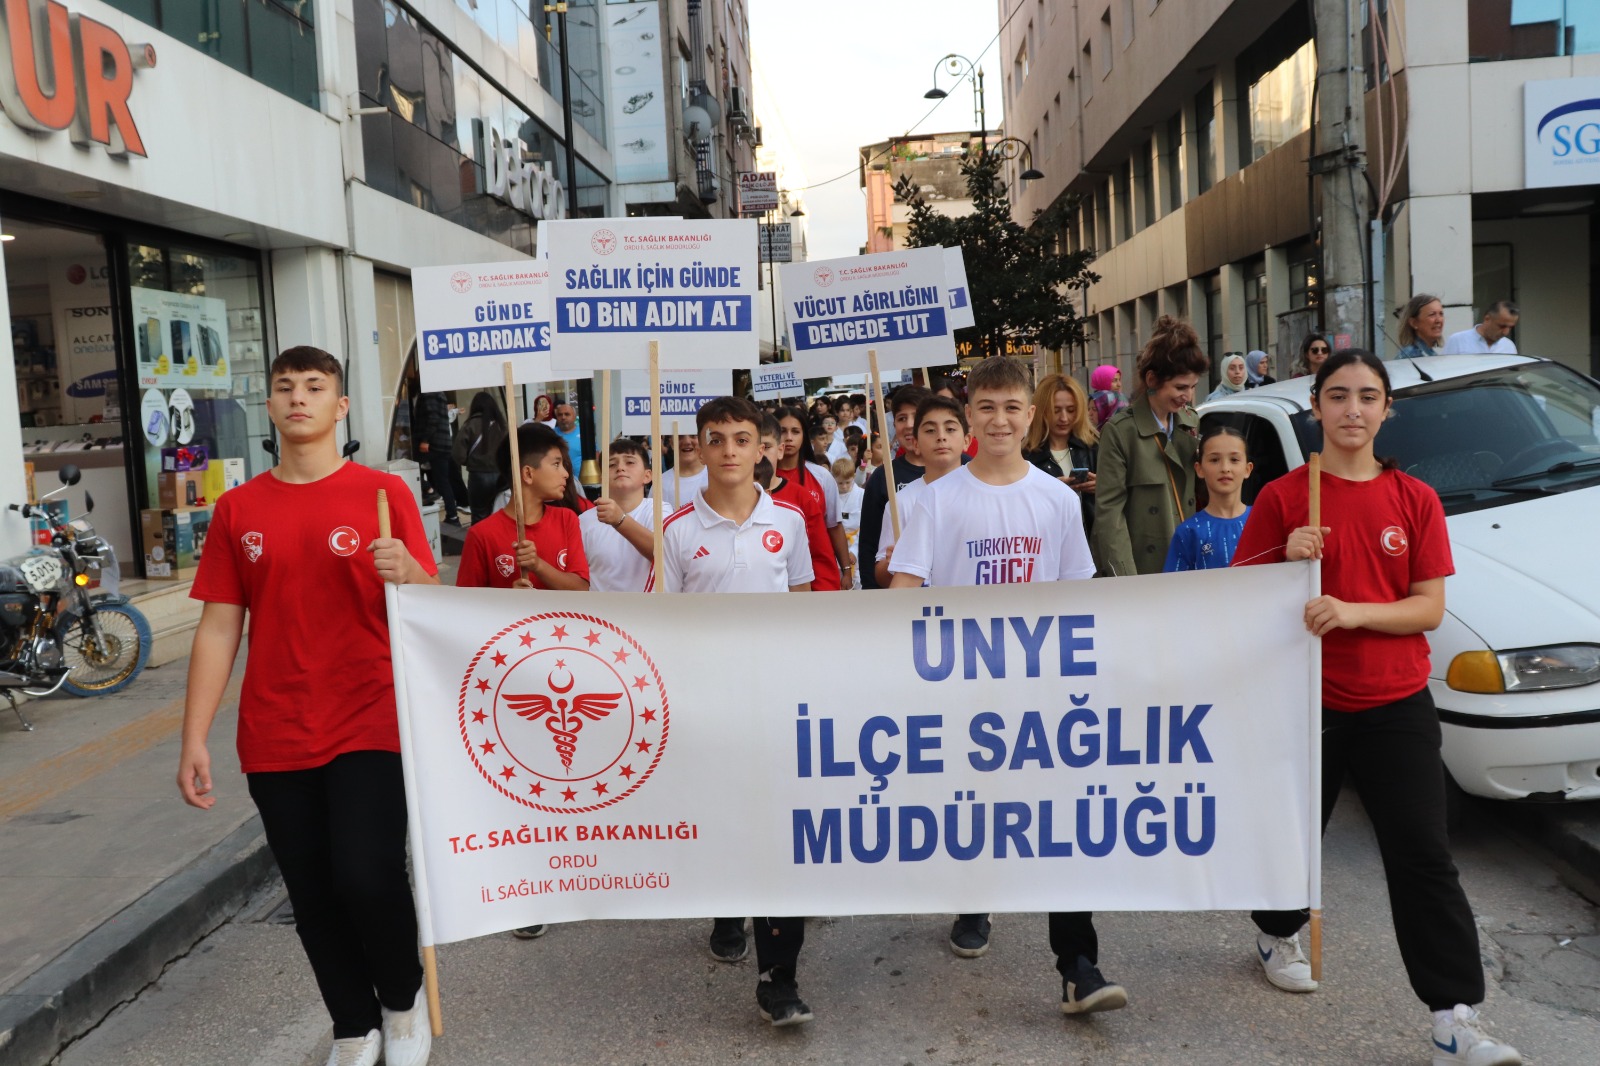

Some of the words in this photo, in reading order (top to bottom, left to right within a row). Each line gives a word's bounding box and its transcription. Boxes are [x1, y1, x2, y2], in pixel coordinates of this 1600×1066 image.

[742, 172, 776, 182] ADALI
[638, 234, 666, 242] SAĞLIK
[668, 234, 711, 242] BAKANLIĞI
[516, 271, 549, 279] BAKANLIĞ
[566, 264, 632, 289] SAĞLIK
[637, 262, 673, 293] İÇİN
[680, 262, 740, 288] GÜNDE
[874, 262, 908, 271] BAKANLIĞI
[72, 306, 110, 317] SON
[475, 300, 533, 322] GÜNDE
[566, 302, 590, 327] 10
[644, 301, 702, 326] ADIM
[710, 300, 741, 325] AT
[794, 295, 846, 318] VÜCUT
[853, 285, 938, 312] AĞIRLIĞINI
[74, 334, 112, 344] ALCAT
[428, 334, 464, 355] 8-10
[468, 327, 536, 352] BARDAK
[540, 326, 550, 346] S
[808, 318, 890, 345] DENGEDE
[893, 313, 930, 335] TUT
[659, 381, 695, 394] GÜNDE
[628, 400, 650, 413] 8-10
[660, 399, 696, 412] ARDAK
[912, 606, 1097, 682] ÜNYE
[796, 703, 944, 792] İLÇE
[968, 693, 1214, 772] SAĞLIK
[792, 781, 1216, 864] MÜDÜRLÜĞÜ
[449, 836, 483, 854] T.C.
[488, 824, 568, 848] SAĞLIK
[576, 821, 698, 840] BAKANLIĞI
[549, 855, 597, 869] ORDU
[481, 886, 494, 903] İL
[498, 879, 554, 900] SAĞLIK
[559, 873, 669, 892] MÜDÜRLÜĞÜ
